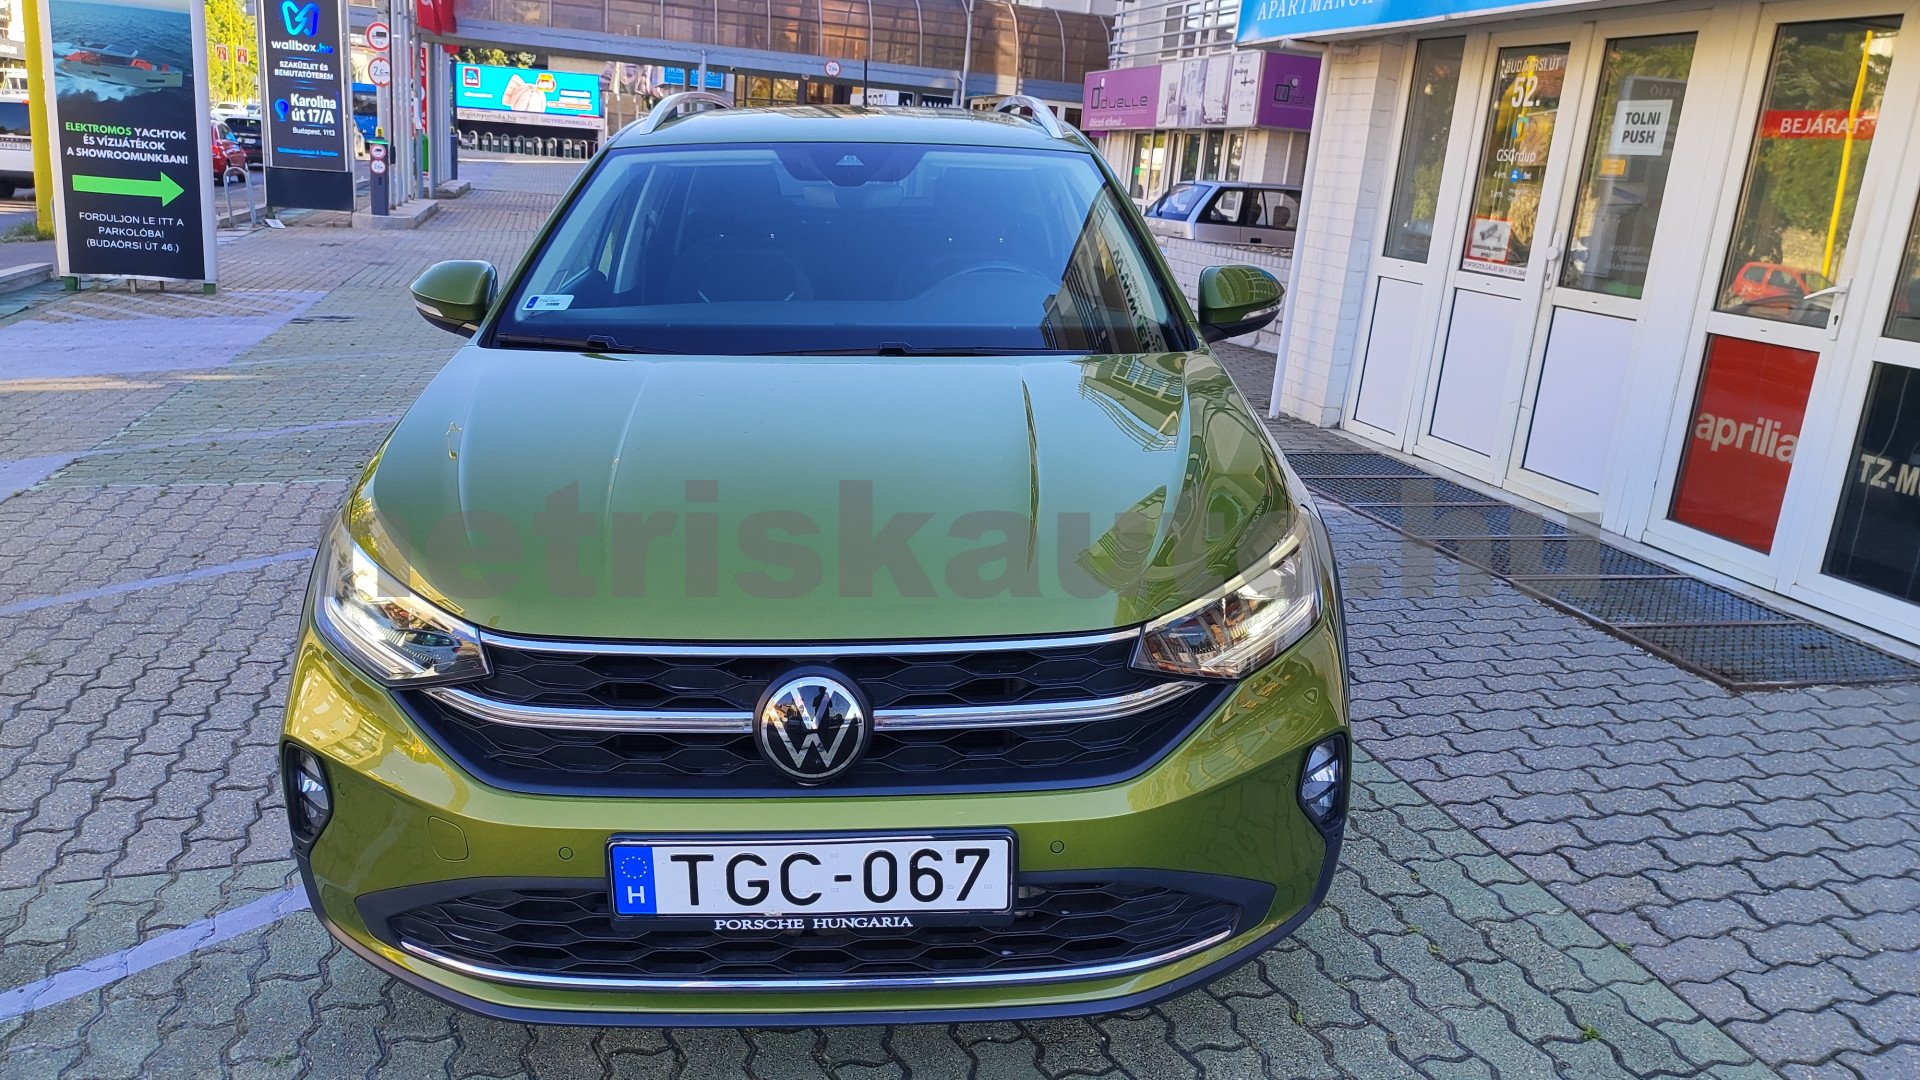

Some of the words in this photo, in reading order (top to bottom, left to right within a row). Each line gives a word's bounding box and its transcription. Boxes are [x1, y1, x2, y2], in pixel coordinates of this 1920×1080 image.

[1257, 0, 1374, 20] APARTMA
[271, 40, 333, 54] wallbox.hu
[274, 68, 334, 81] BEMUTATÓTEREM
[279, 60, 319, 71] SZAKÜZLET
[319, 62, 329, 72] ÉS
[1511, 75, 1541, 108] 52.
[290, 93, 337, 110] Karolina
[291, 107, 306, 122] út
[306, 108, 335, 125] 17/A
[1625, 111, 1662, 126] TOLNI
[1779, 114, 1865, 135] BEJÁRAT
[65, 121, 132, 136] ELEKTROMOS
[133, 127, 187, 141] YACHTOK
[1621, 130, 1656, 144] PUSH
[83, 133, 95, 145] ÉS
[96, 135, 166, 151] VÍZIJÁTÉKOK
[66, 146, 75, 156] A
[76, 147, 189, 165] SHOWROOMUNKBAN!
[79, 211, 140, 225] FORDULJON
[142, 216, 155, 226] LE
[158, 217, 174, 226] ITT
[176, 218, 185, 227] A
[98, 226, 165, 239] PARKOLÓBA!
[86, 238, 142, 251] (BUDAÖRSI
[144, 240, 159, 251] ÚT
[161, 243, 180, 254] 46.)
[1695, 413, 1801, 464] aprilia
[1859, 453, 1920, 497] TZ-M
[626, 885, 646, 904] H
[669, 847, 991, 907] TGC-067
[714, 916, 805, 931] PORSCHE
[813, 915, 914, 930] HUNGARIA
